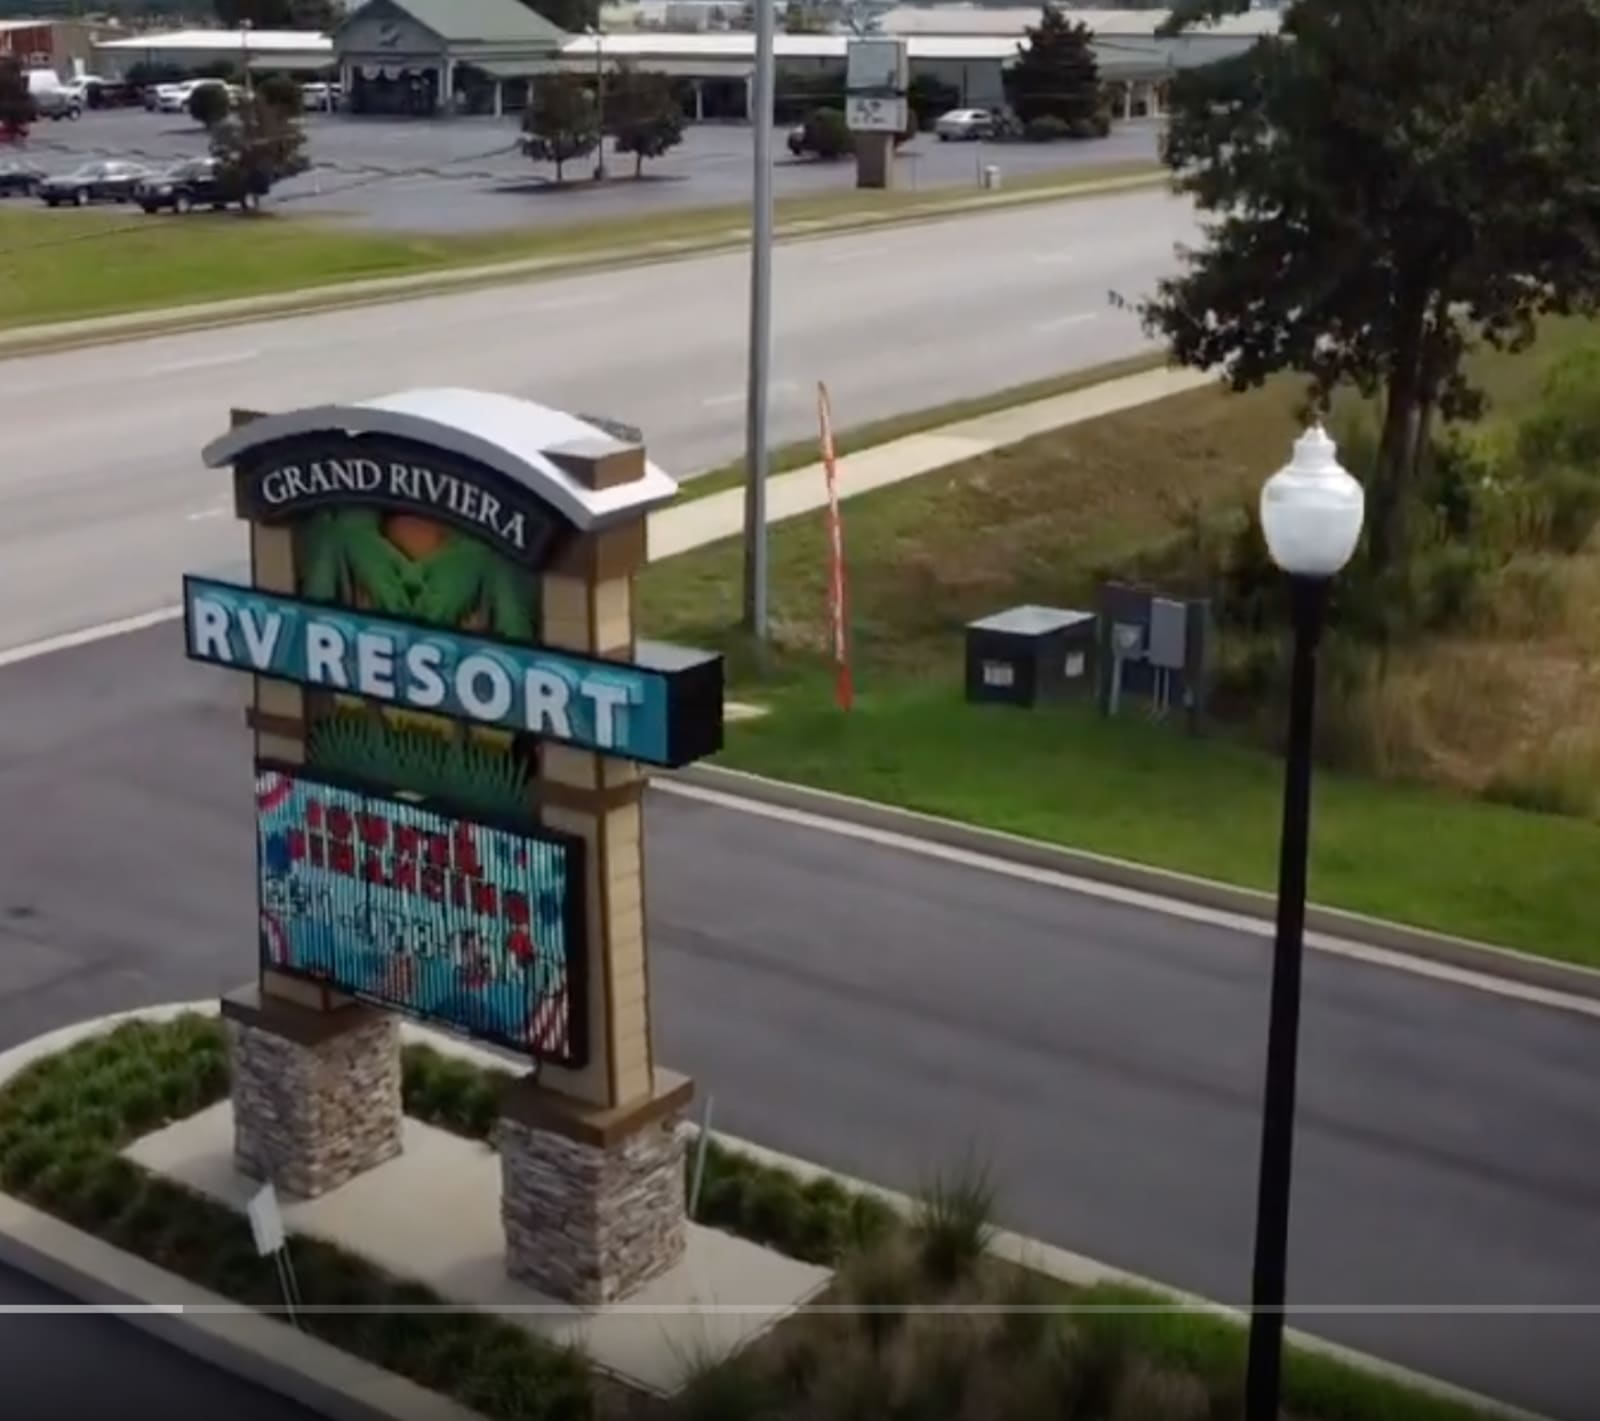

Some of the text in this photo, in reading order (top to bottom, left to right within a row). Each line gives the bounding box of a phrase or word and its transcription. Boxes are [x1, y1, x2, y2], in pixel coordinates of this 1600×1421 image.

[262, 458, 526, 548] GRAND RIVIERA
[195, 600, 631, 748] RV RESORT
